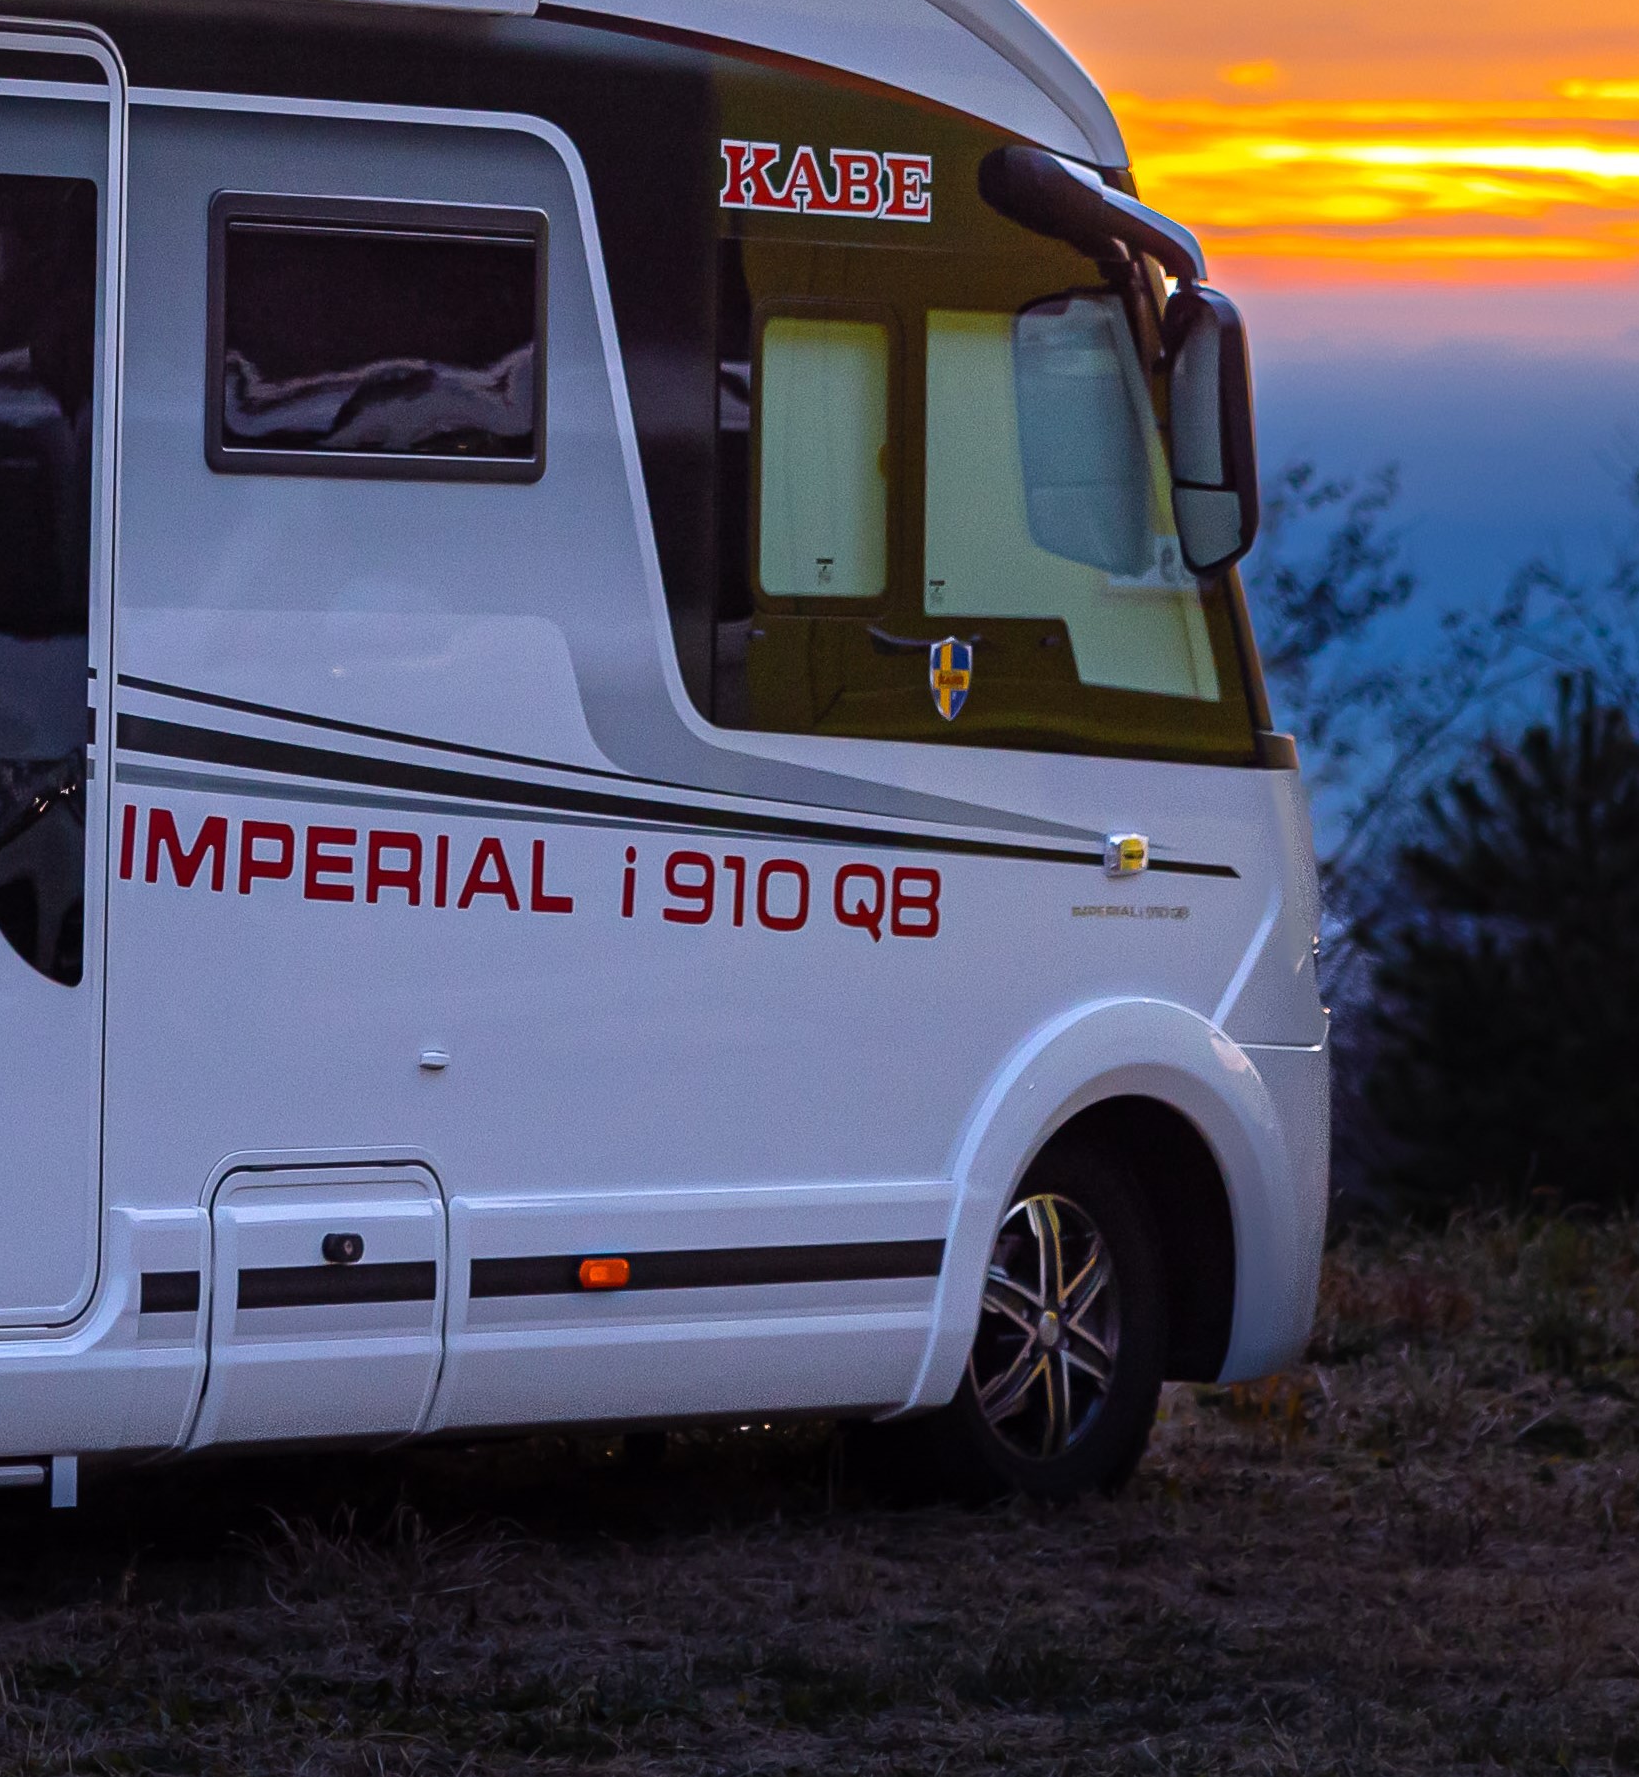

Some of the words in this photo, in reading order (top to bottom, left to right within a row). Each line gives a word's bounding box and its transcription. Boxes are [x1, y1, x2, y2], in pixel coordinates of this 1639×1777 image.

[719, 138, 932, 223] KABE
[119, 804, 574, 914] IMPERIAL
[662, 851, 809, 932] 910
[835, 863, 941, 943] QB
